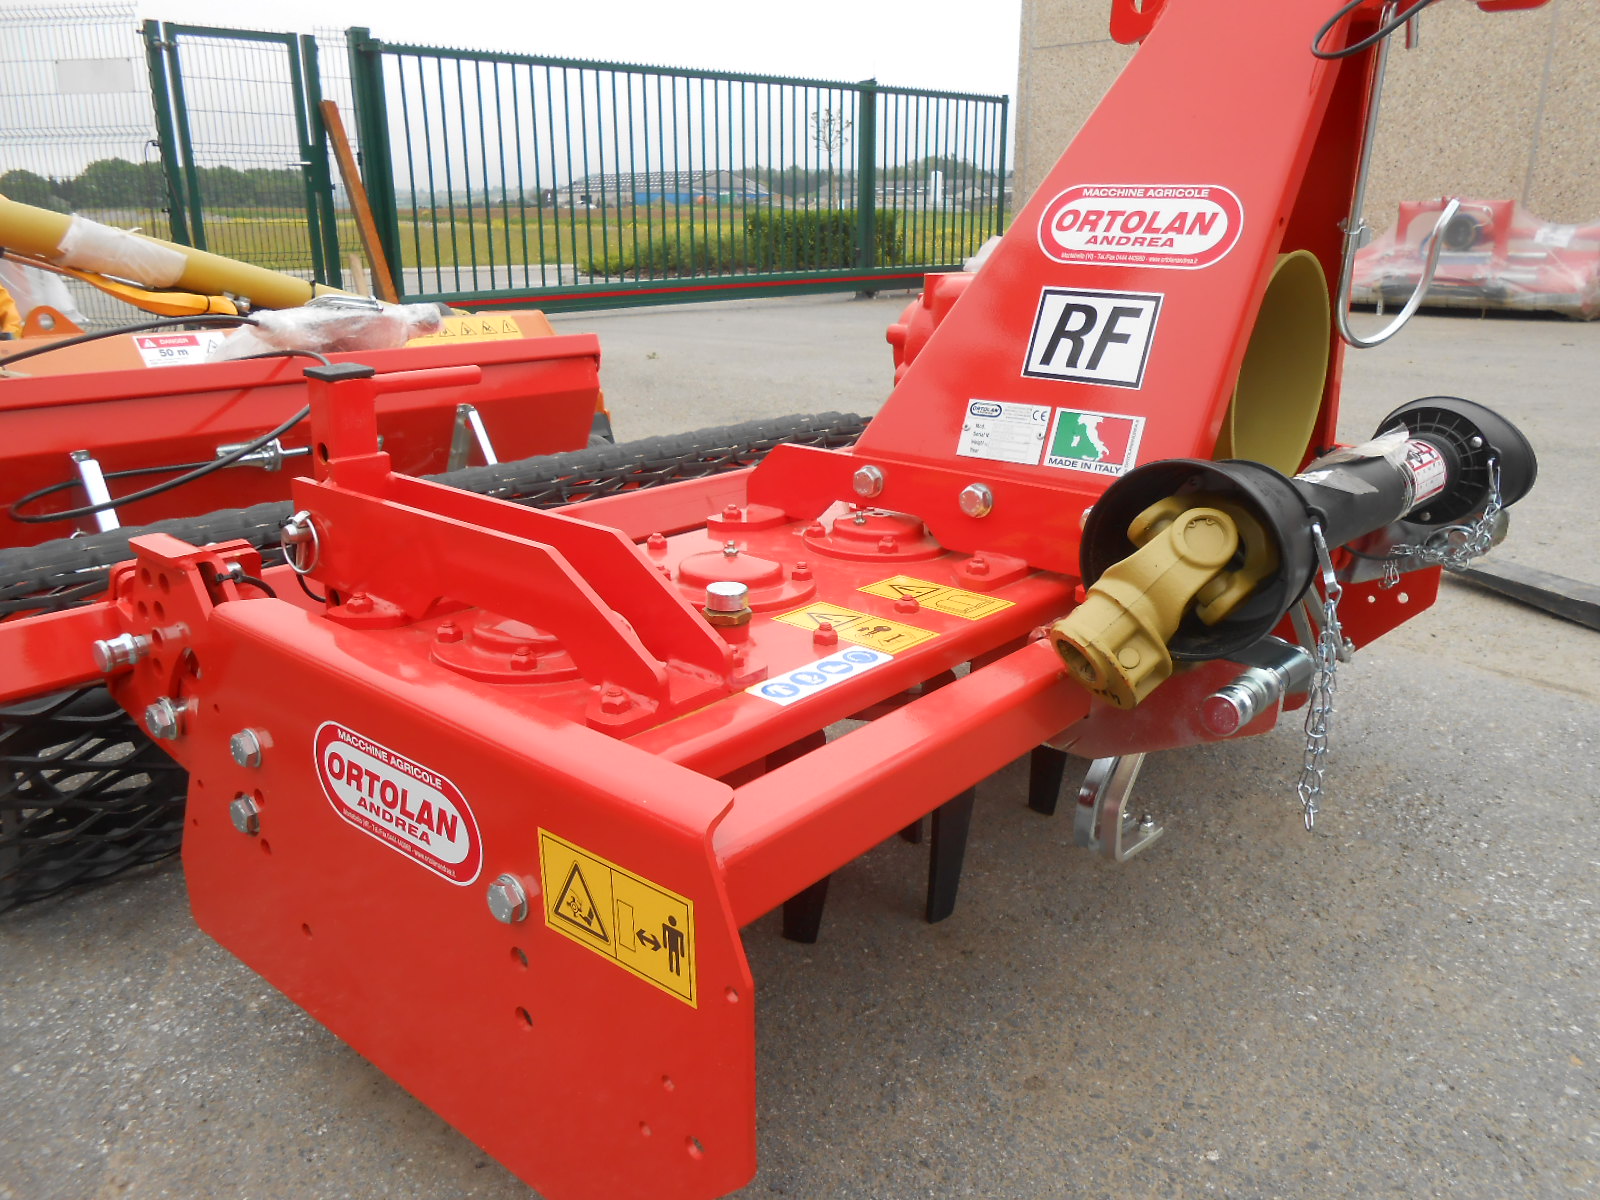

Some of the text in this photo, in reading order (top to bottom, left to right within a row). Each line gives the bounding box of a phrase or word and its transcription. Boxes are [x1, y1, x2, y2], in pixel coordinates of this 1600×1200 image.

[1082, 188, 1210, 198] MACCHINE AGRICOLE
[1055, 209, 1219, 236] ORTOLAN
[1084, 235, 1175, 248] ANDREA
[159, 337, 189, 345] DANGER
[1039, 303, 1144, 371] RF
[159, 348, 174, 357] 50
[972, 405, 1000, 413] ORTOLAN
[1032, 409, 1048, 422] CE
[1048, 457, 1122, 475] MADE IN ITALY
[337, 728, 443, 791] MACCHINE AGRICOLE
[327, 751, 458, 844] ORTOLAN
[356, 796, 432, 847] ANDREA
